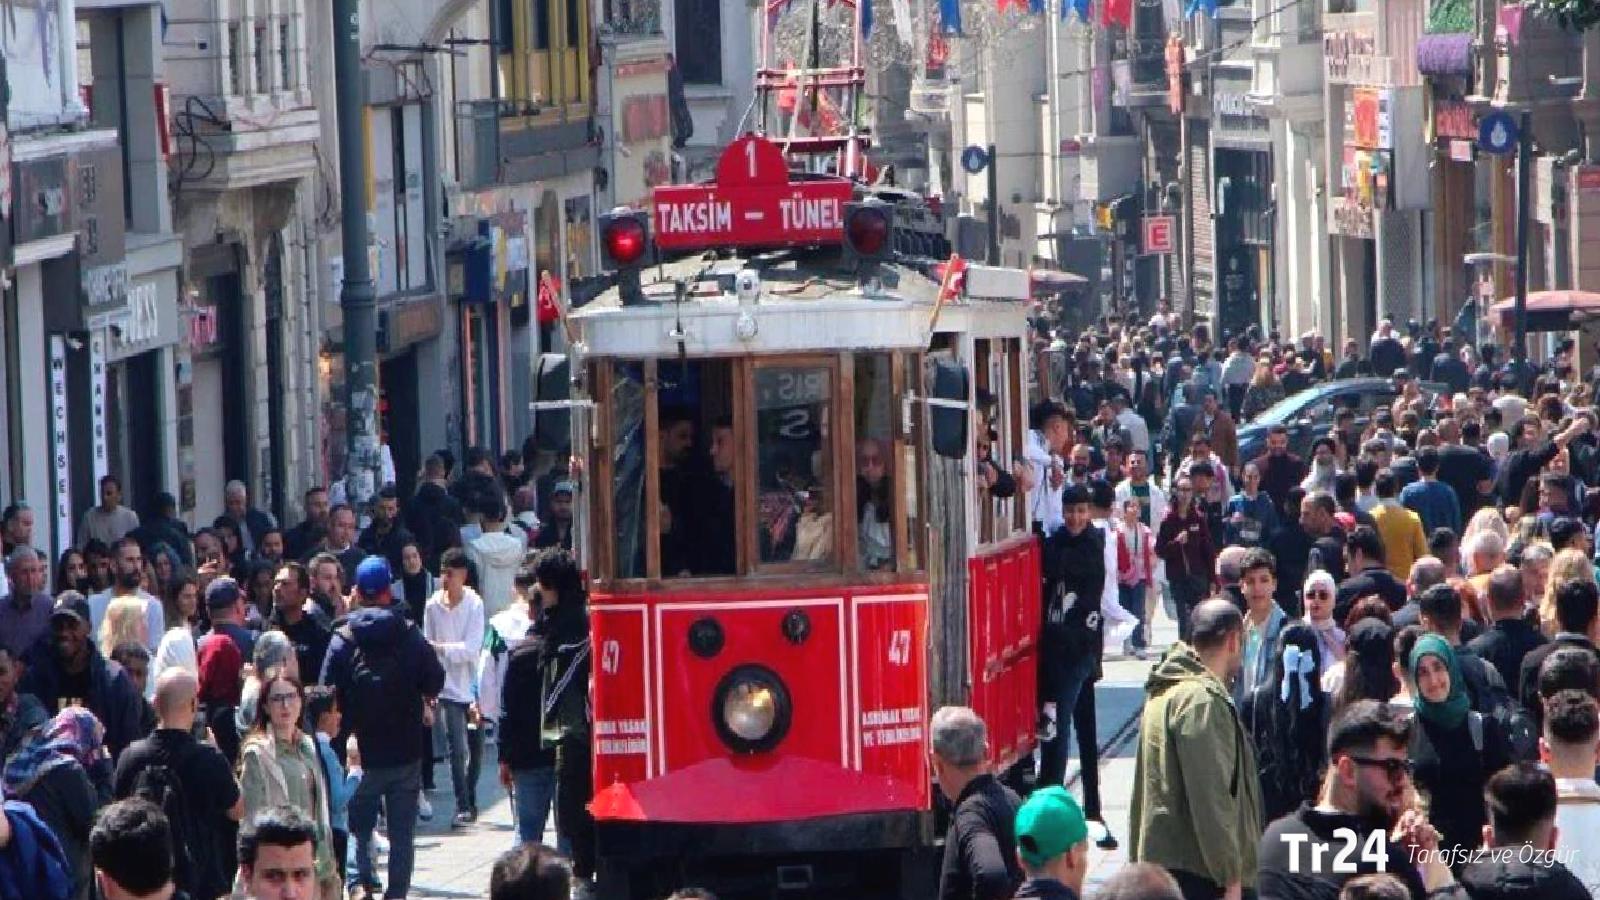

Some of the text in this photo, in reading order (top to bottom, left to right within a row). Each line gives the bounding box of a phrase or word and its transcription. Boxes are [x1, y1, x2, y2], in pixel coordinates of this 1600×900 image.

[746, 140, 758, 178] 1
[657, 193, 732, 233] TAKSİM
[779, 192, 844, 230] TÜNEL
[1151, 223, 1169, 246] E
[50, 357, 67, 518] WECHSEL
[602, 639, 620, 676] 47
[888, 629, 911, 667] 47
